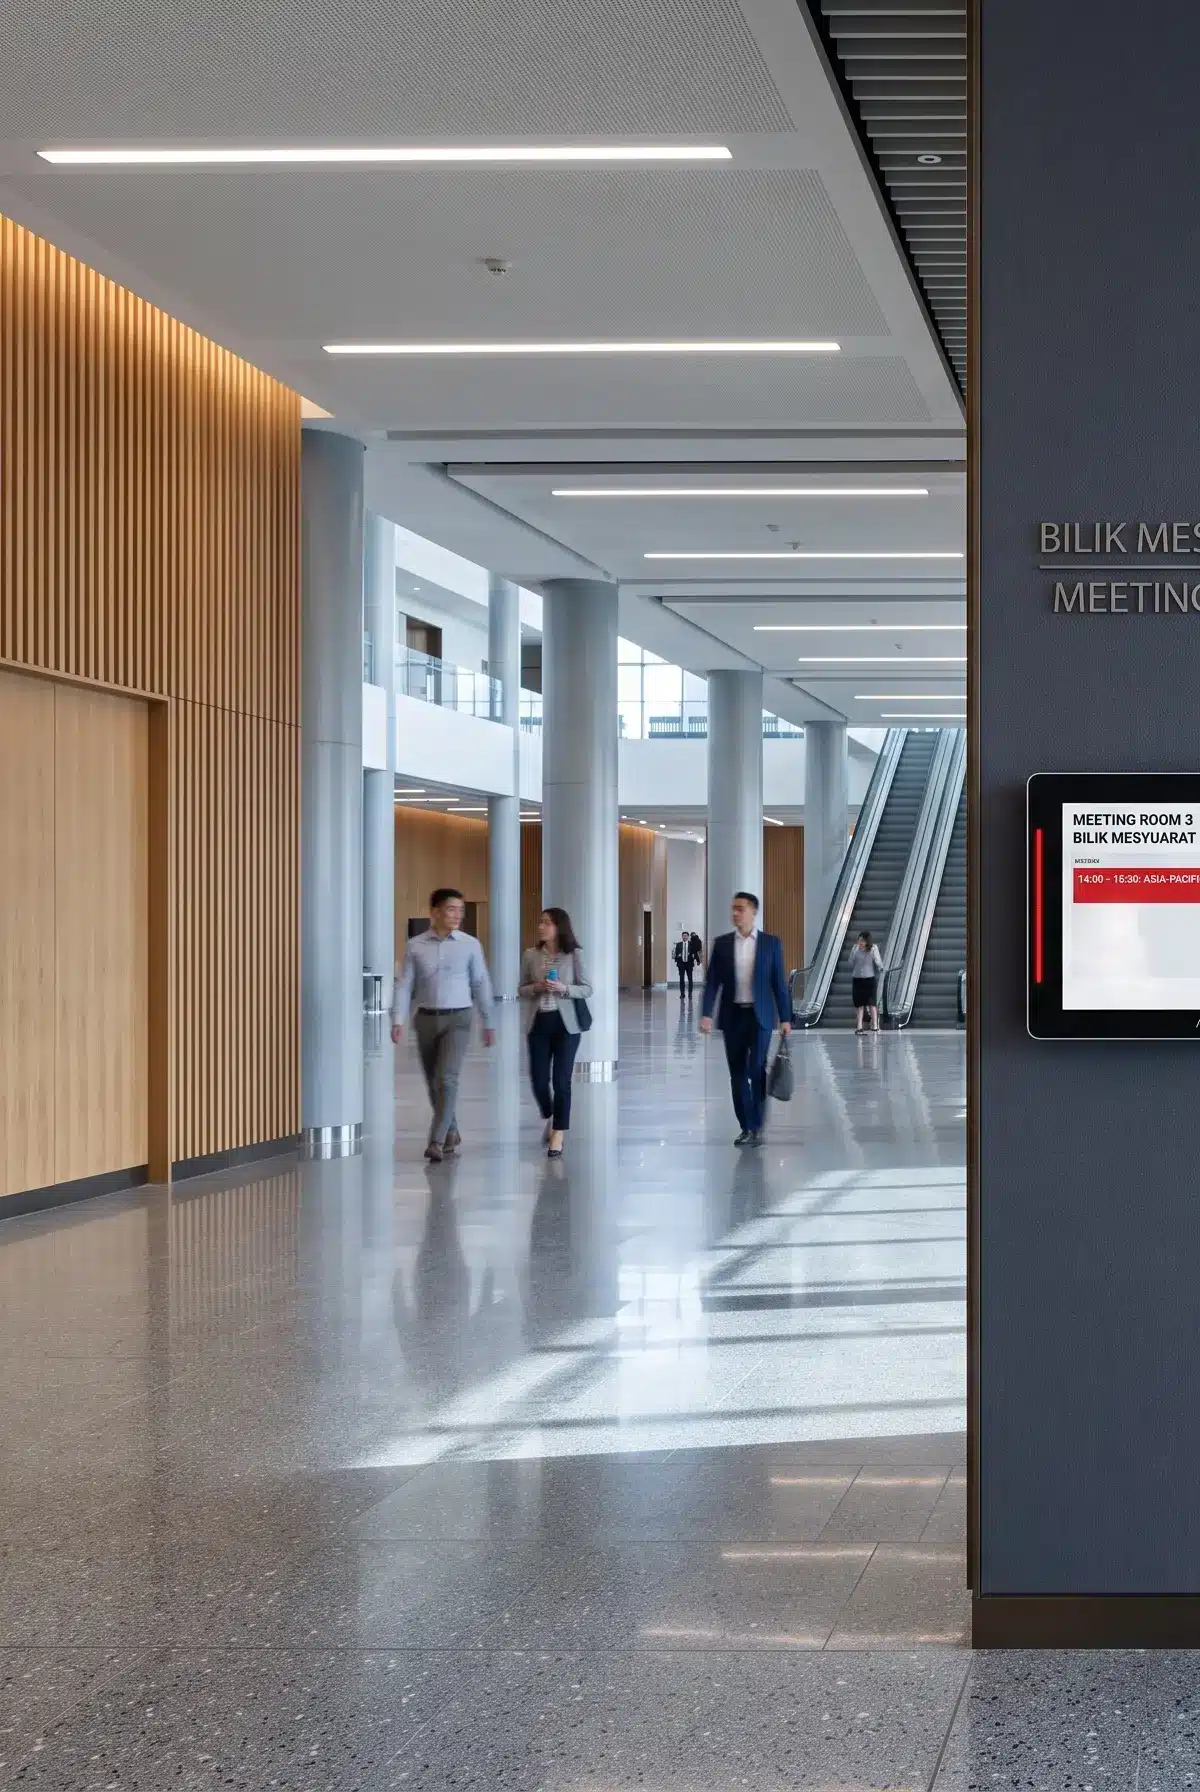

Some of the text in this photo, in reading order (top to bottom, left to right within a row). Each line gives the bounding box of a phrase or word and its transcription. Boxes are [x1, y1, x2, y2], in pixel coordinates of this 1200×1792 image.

[1040, 522, 1127, 553] BILIK
[1073, 813, 1193, 826] MEETING ROOM 3
[1073, 832, 1108, 844] BILIK
[1112, 831, 1196, 844] MESYUARAT
[1078, 874, 1104, 884] 14:00
